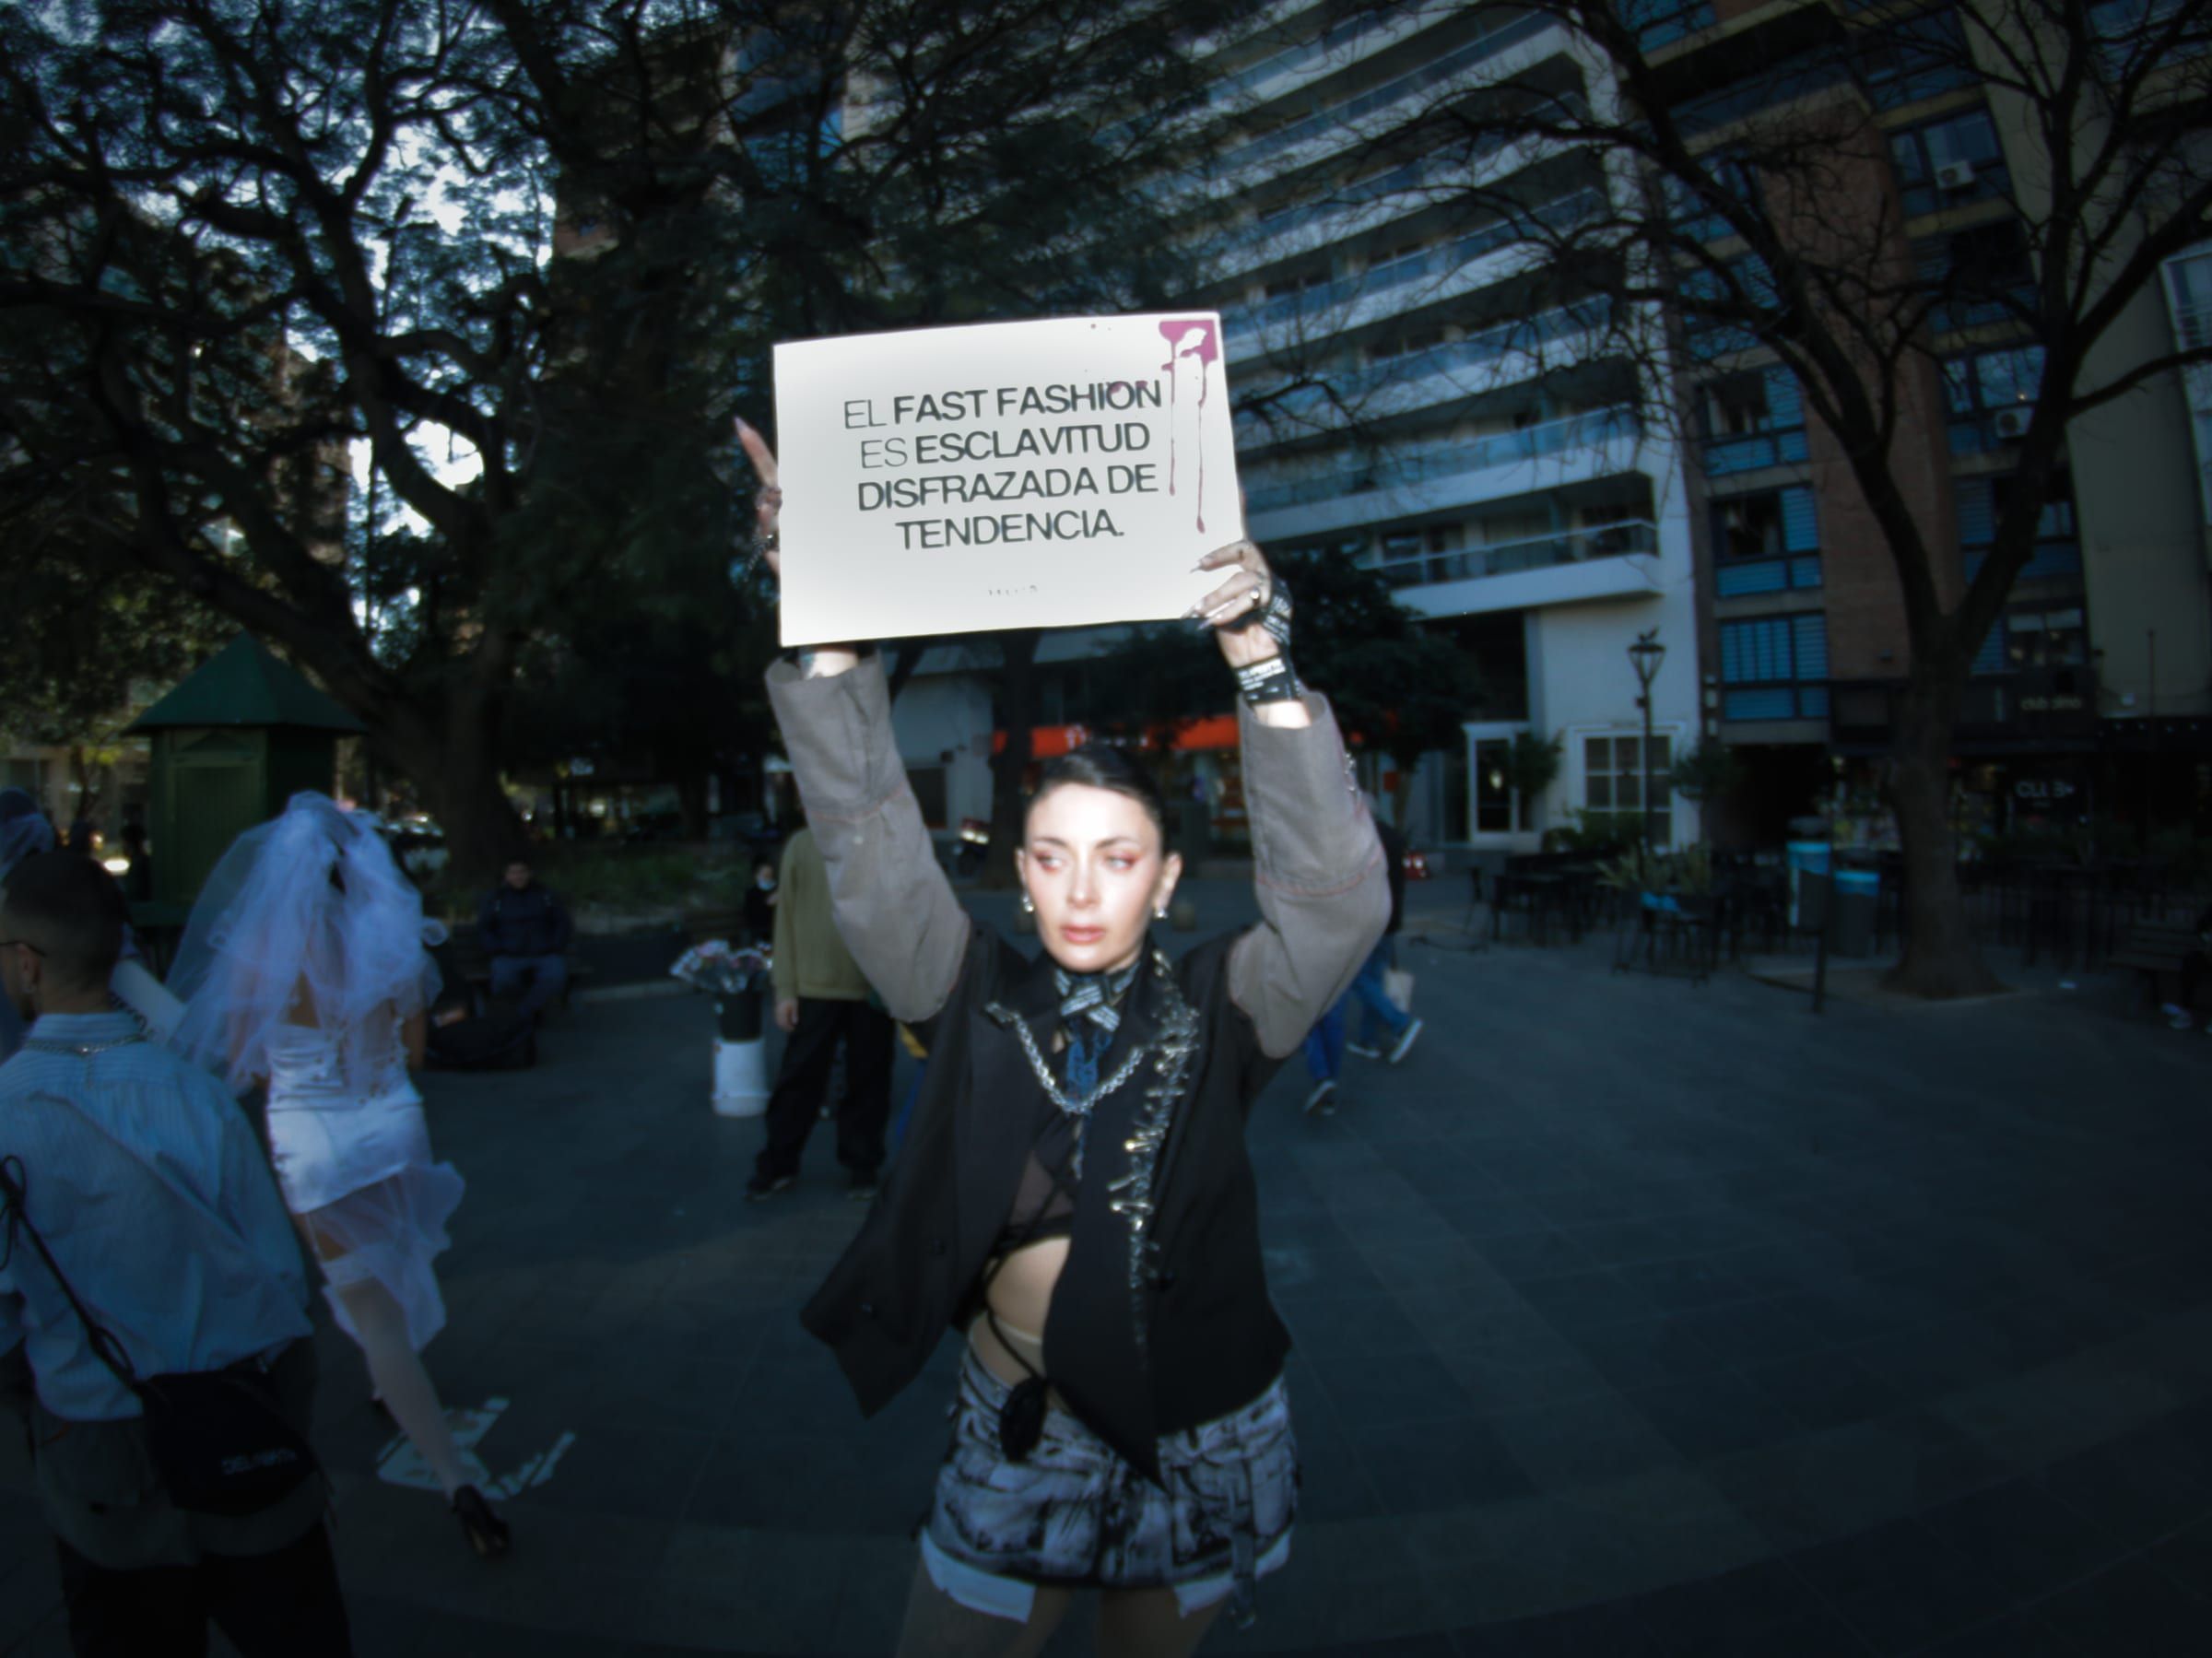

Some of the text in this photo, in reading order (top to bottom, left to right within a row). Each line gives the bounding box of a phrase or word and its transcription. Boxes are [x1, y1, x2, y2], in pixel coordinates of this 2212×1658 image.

[843, 379, 1162, 429] EL FAST FASHION
[860, 421, 1151, 468] ES ESCLAVITUD
[857, 463, 1159, 512] DISFRAZADA DE
[894, 508, 1125, 550] TENDENCIA.
